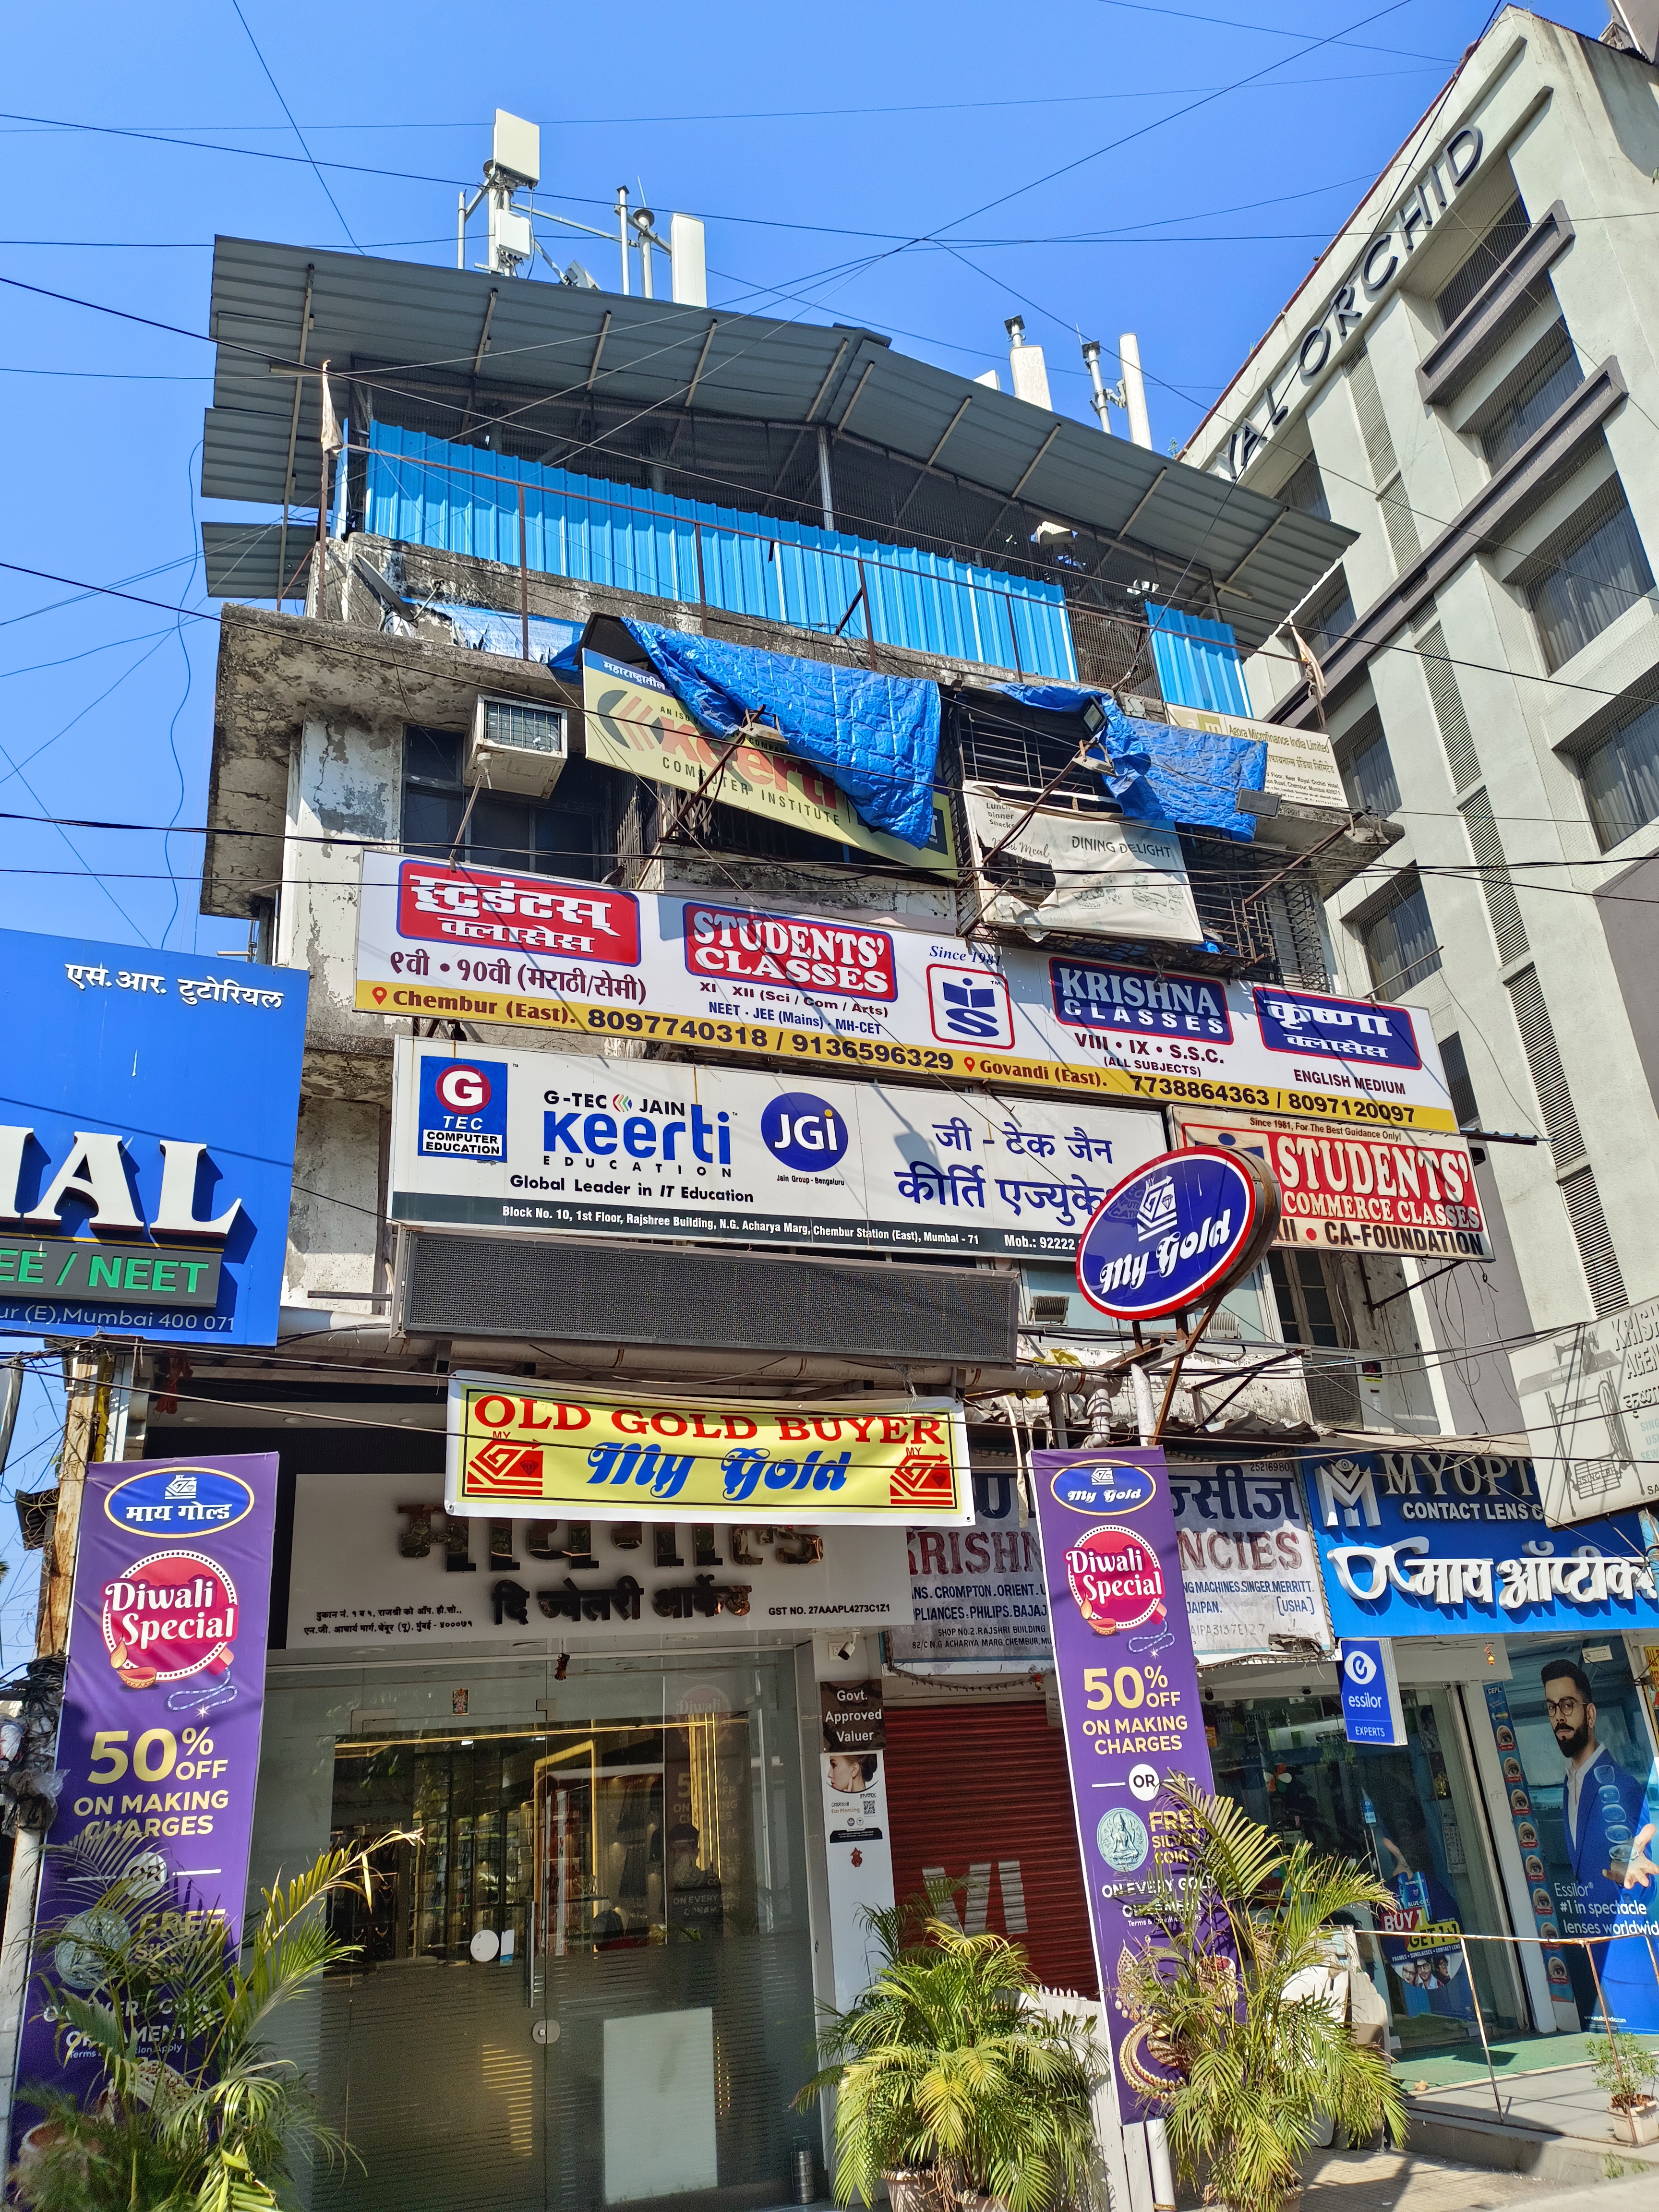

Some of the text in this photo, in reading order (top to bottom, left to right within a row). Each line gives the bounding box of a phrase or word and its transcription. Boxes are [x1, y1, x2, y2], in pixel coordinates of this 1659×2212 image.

[1298, 124, 1483, 376] ORCHID
[1229, 725, 1329, 753] Agora Microfinance India Limited
[761, 790, 840, 826] INSTITUTE
[988, 811, 1014, 819] Dinner
[1072, 836, 1170, 858] DINING DELIGHT
[929, 945, 1000, 967] Since 1981
[695, 947, 888, 994] CLASSES
[394, 990, 497, 1014] Chembur
[700, 982, 888, 1018] XI XII Com Arts)
[1057, 966, 1221, 1016] KRISHNA
[709, 1001, 881, 1035] NEET JEE (Mains) MH-CET
[1063, 998, 1224, 1035] CLASSES
[588, 1008, 953, 1070] 8097740318 9136596329
[1075, 1033, 1225, 1064] VIII IX S.S.C.
[980, 1058, 1050, 1081] Govandi
[1104, 1055, 1202, 1078] (ALL SUBJECTS)
[1294, 1069, 1406, 1095] ENGLISH MEDIUM
[544, 1091, 685, 1117] G-TEC JAIN
[1130, 1075, 1415, 1123] 7738864363 8097120097
[443, 1116, 483, 1130] TEC
[1250, 1117, 1402, 1141] Since 1981, For The Best Guidance Only!
[426, 1142, 500, 1155] EDUCATION
[427, 1131, 498, 1145] COMPUTER
[932, 1117, 1112, 1165] जी टेक जैन
[543, 1156, 732, 1178] EDUCATION
[510, 1174, 754, 1203] Global Leader in IT Education
[777, 1174, 844, 1187] Jain Group Bengaluru
[1283, 1191, 1481, 1229] COMMERCE CLASSES
[503, 1206, 1076, 1250] Block No. 10, 1st Floor, Rajshree Building, N.G. Acharya Marg, Chembur Station (East), Mumbai 71 Mob.: 92222
[1326, 1220, 1483, 1255] CA-FOUNDATION
[1099, 1210, 1231, 1295] My Gold
[88, 1254, 210, 1294] NEET
[159, 1311, 235, 1331] 400 071
[474, 1395, 946, 1445] OLD GOLD BUYER
[587, 1441, 852, 1502] My Gold
[1067, 1489, 1142, 1503] My Gold
[126, 1504, 173, 1522] माय
[1403, 1502, 1528, 1521] CONTACT LENS
[1066, 1548, 1142, 1574] Diwali
[105, 1579, 213, 1611] Diwali
[1082, 1571, 1162, 1604] Special
[769, 1606, 788, 1616] GST
[790, 1606, 806, 1615] NO.
[122, 1608, 235, 1650] Special
[938, 1625, 1046, 1636] SHOP BUILDING
[945, 1639, 979, 1647] ACHARIYA
[837, 1690, 868, 1701] Govt.
[1146, 1691, 1180, 1708] OFF
[1348, 1693, 1382, 1709] essilor
[825, 1708, 882, 1724] Approved
[1082, 1715, 1188, 1736] ON MAKING
[836, 1731, 874, 1743] Valuer
[1355, 1726, 1386, 1738] EXPERTS
[1095, 1735, 1182, 1755] CHARGES
[176, 1759, 228, 1780] OFF
[1133, 1775, 1155, 1788] OR
[73, 1790, 229, 1816] ON MAKING
[84, 1815, 214, 1841] CHARGES
[1560, 1900, 1647, 1917] #1 in spectacle
[1384, 1911, 1413, 1932] BUY
[1563, 1921, 1601, 1935] lenses
